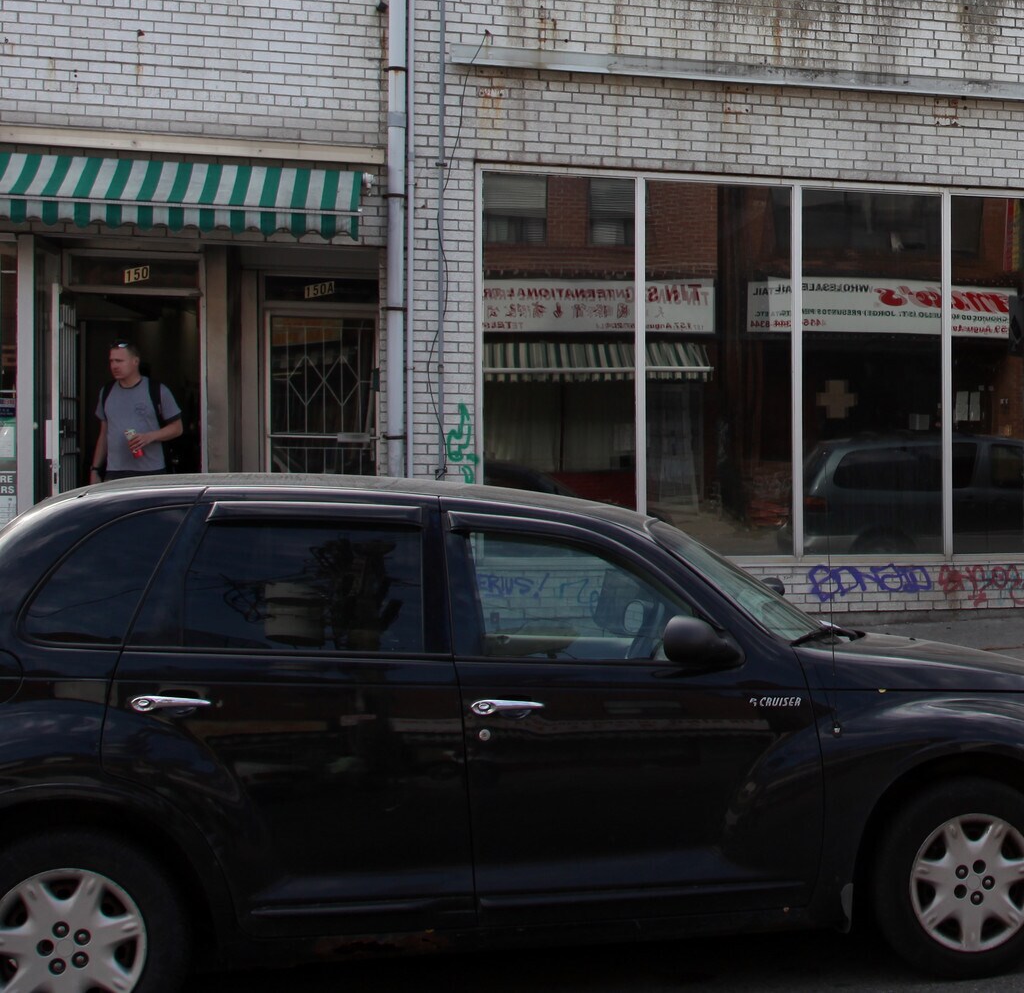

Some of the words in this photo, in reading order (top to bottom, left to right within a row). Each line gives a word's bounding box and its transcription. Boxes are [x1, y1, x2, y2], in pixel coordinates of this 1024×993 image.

[124, 266, 149, 283] 150
[305, 282, 335, 297] 150A
[759, 696, 802, 707] CRUISER
